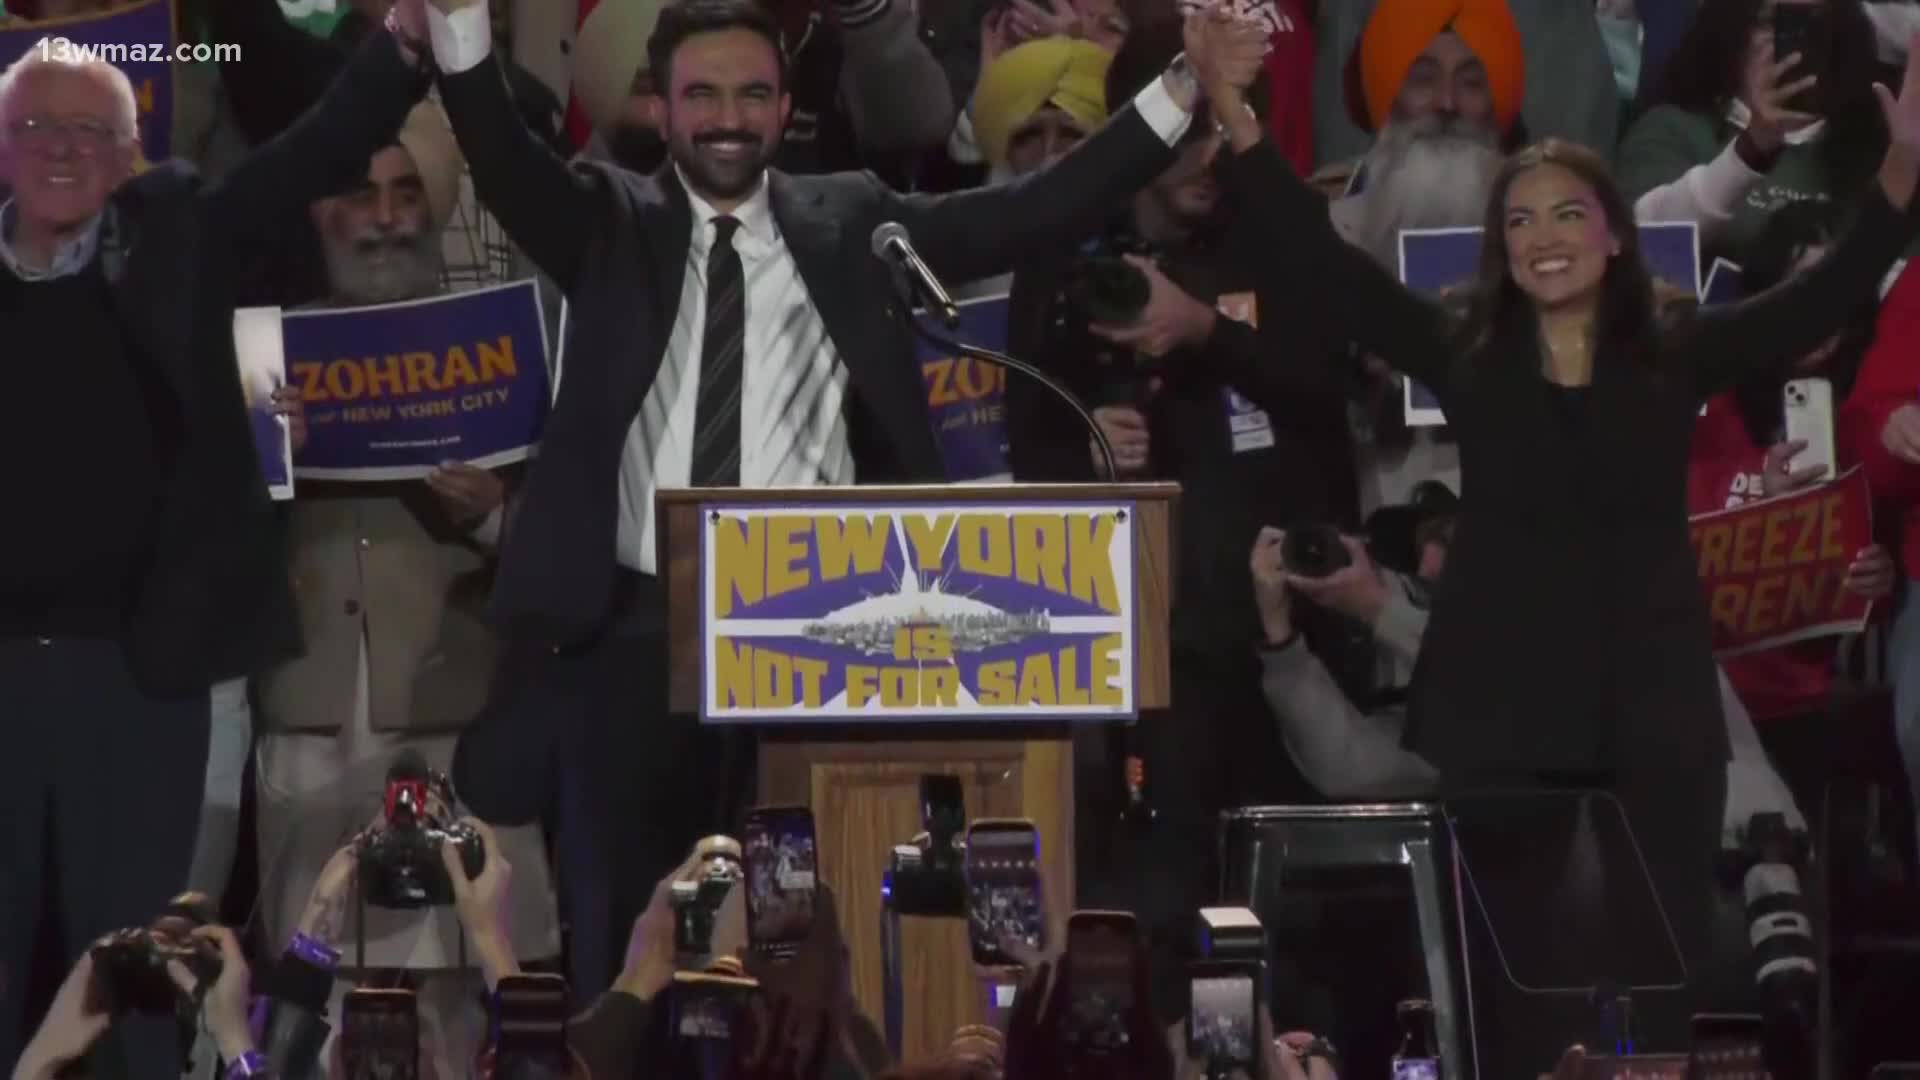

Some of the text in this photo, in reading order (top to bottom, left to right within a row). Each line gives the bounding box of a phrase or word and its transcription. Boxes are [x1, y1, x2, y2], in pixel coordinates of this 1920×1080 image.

[292, 335, 517, 400] ZOHRAN
[922, 356, 1006, 407] ZO
[342, 405, 392, 424] NEW
[397, 400, 457, 420] YORK
[461, 387, 509, 413] CITY
[1729, 471, 1764, 496] DE
[715, 511, 1121, 619] NEW YORK
[892, 622, 952, 661] IS
[715, 631, 1122, 709] NOT FOR SALE
